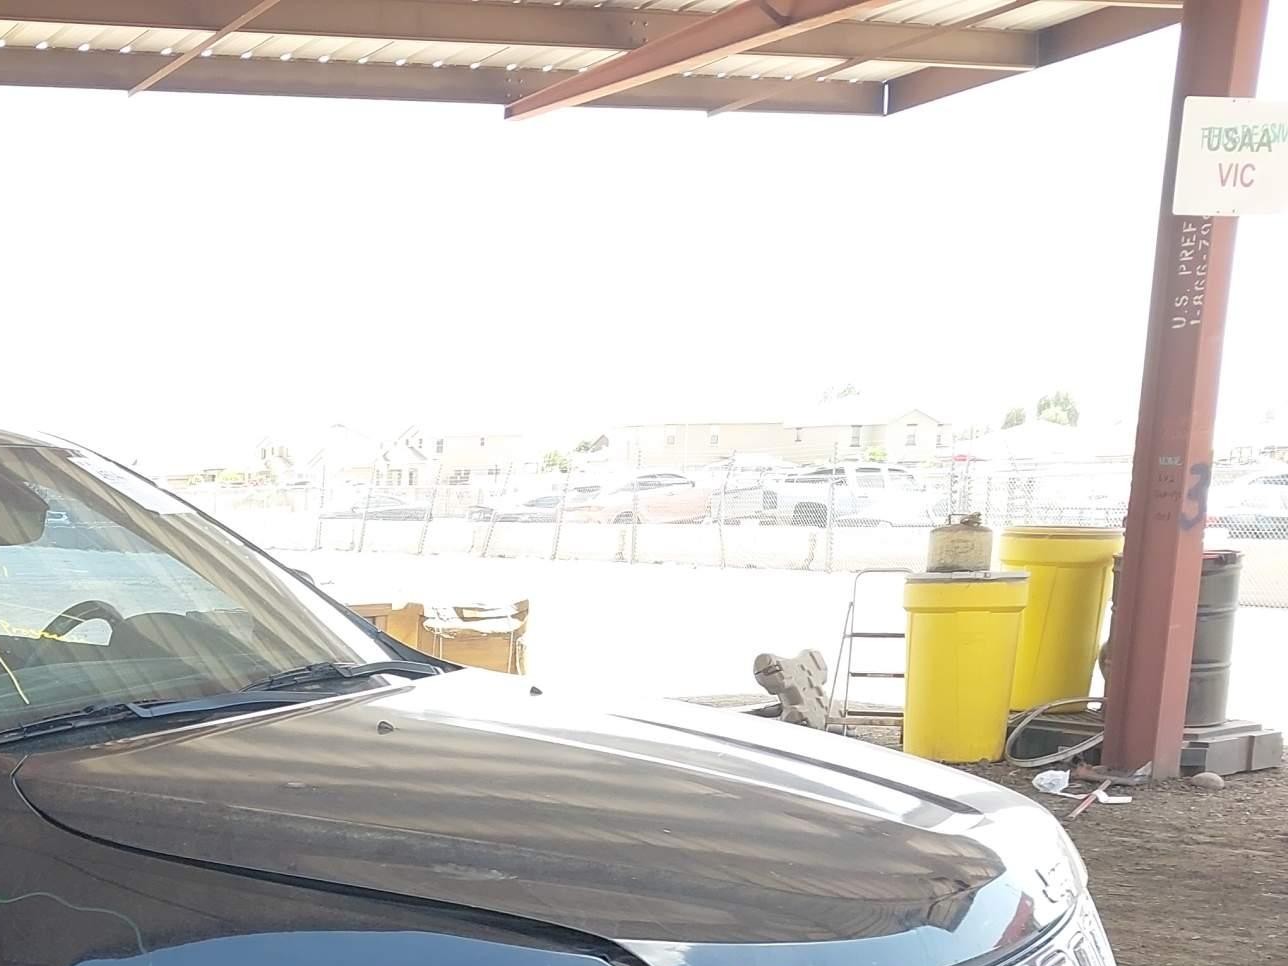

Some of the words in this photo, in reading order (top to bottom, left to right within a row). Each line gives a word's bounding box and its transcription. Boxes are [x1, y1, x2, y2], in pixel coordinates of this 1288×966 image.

[1206, 126, 1272, 153] USAA
[1218, 163, 1256, 188] VIC
[1177, 462, 1212, 531] 3
